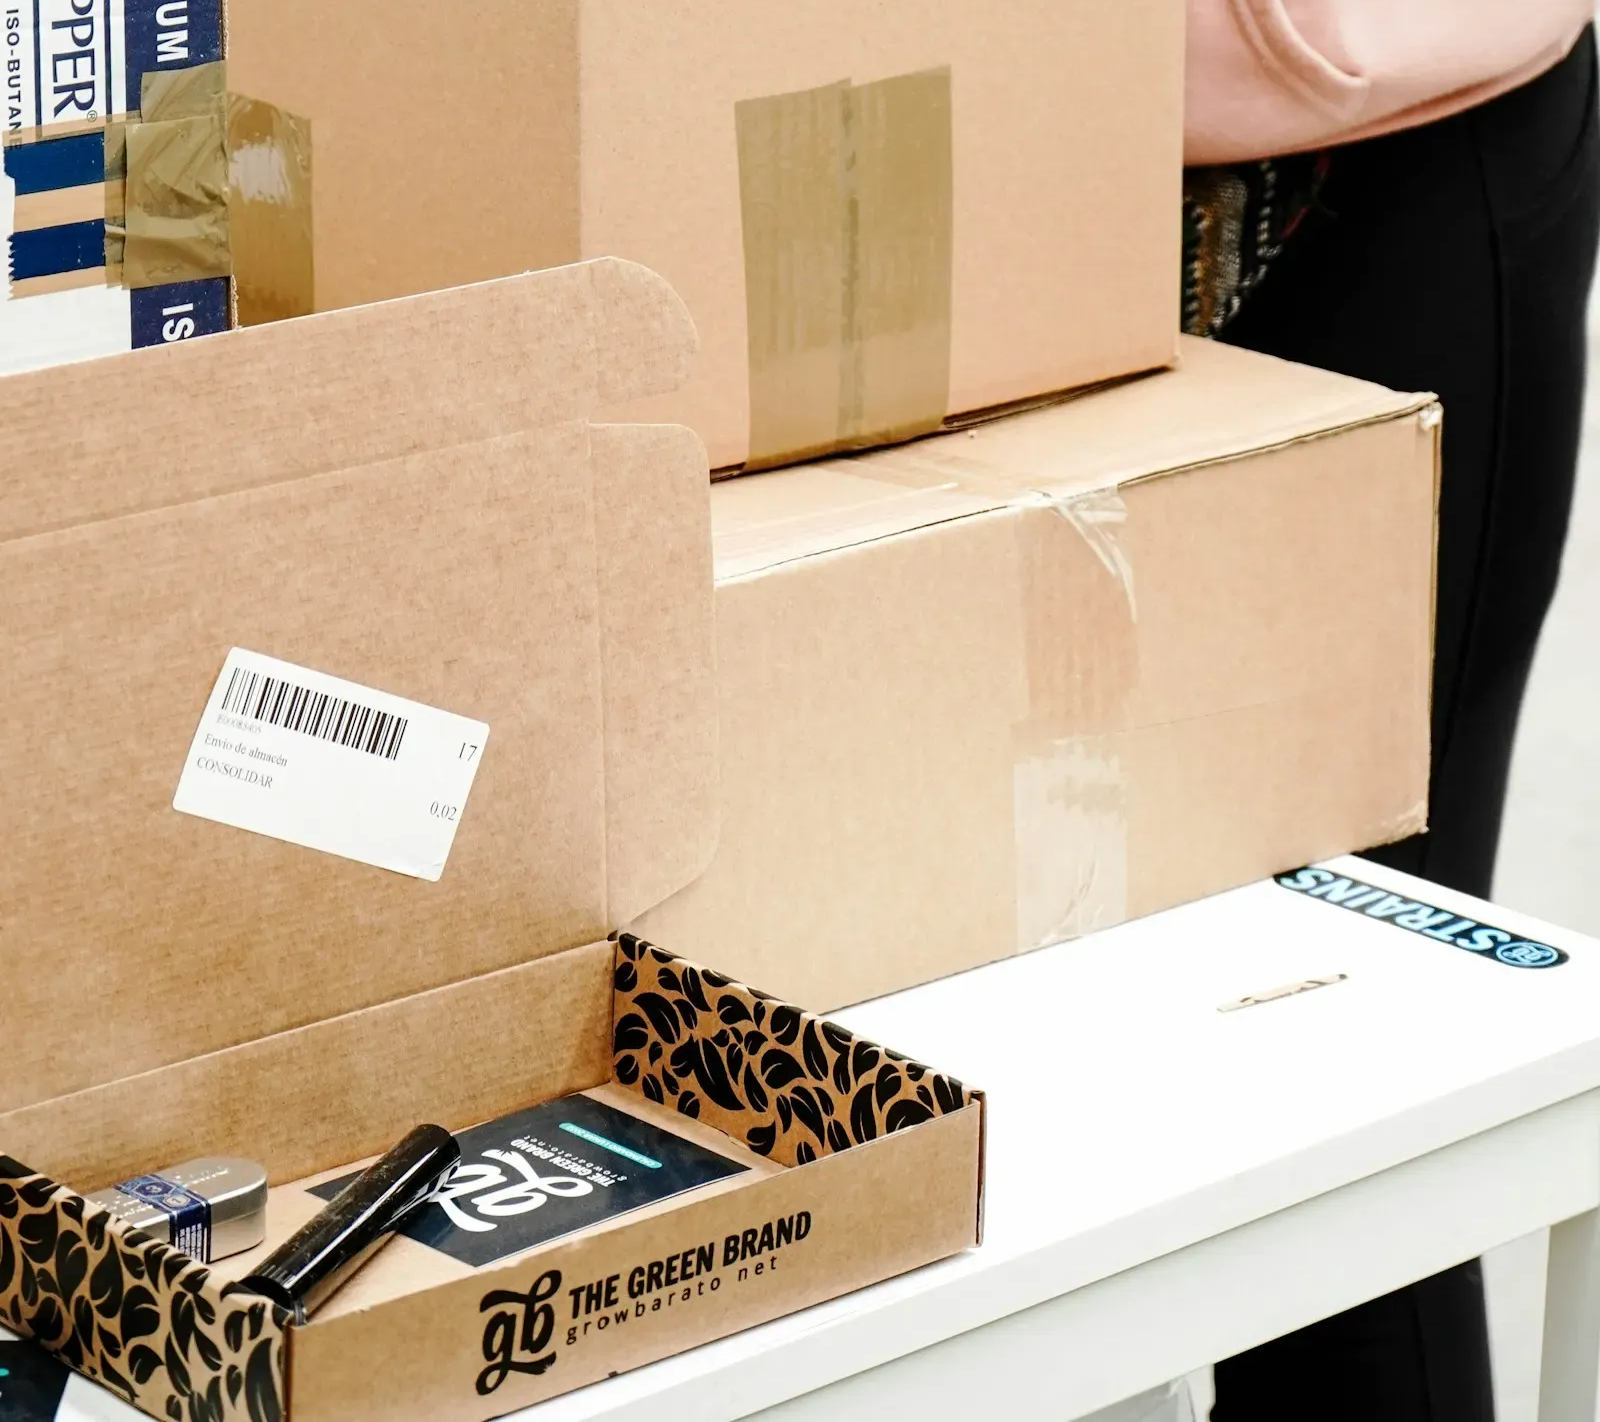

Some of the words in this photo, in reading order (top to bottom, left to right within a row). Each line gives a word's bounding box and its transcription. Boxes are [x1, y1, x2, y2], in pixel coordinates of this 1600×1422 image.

[162, 302, 195, 342] IS
[234, 742, 247, 755] de
[459, 742, 478, 762] 17
[197, 756, 273, 789] CONSOLIDAR
[1280, 868, 1511, 951] STRAINS
[510, 1138, 555, 1161] BRAND
[548, 1155, 593, 1177] GREEN
[587, 1173, 616, 1188] THE
[568, 1274, 620, 1319] THE
[627, 1242, 716, 1300] GREEN
[722, 1210, 812, 1268] BRAND
[566, 1277, 721, 1345] growbarato
[737, 1255, 778, 1282] net
